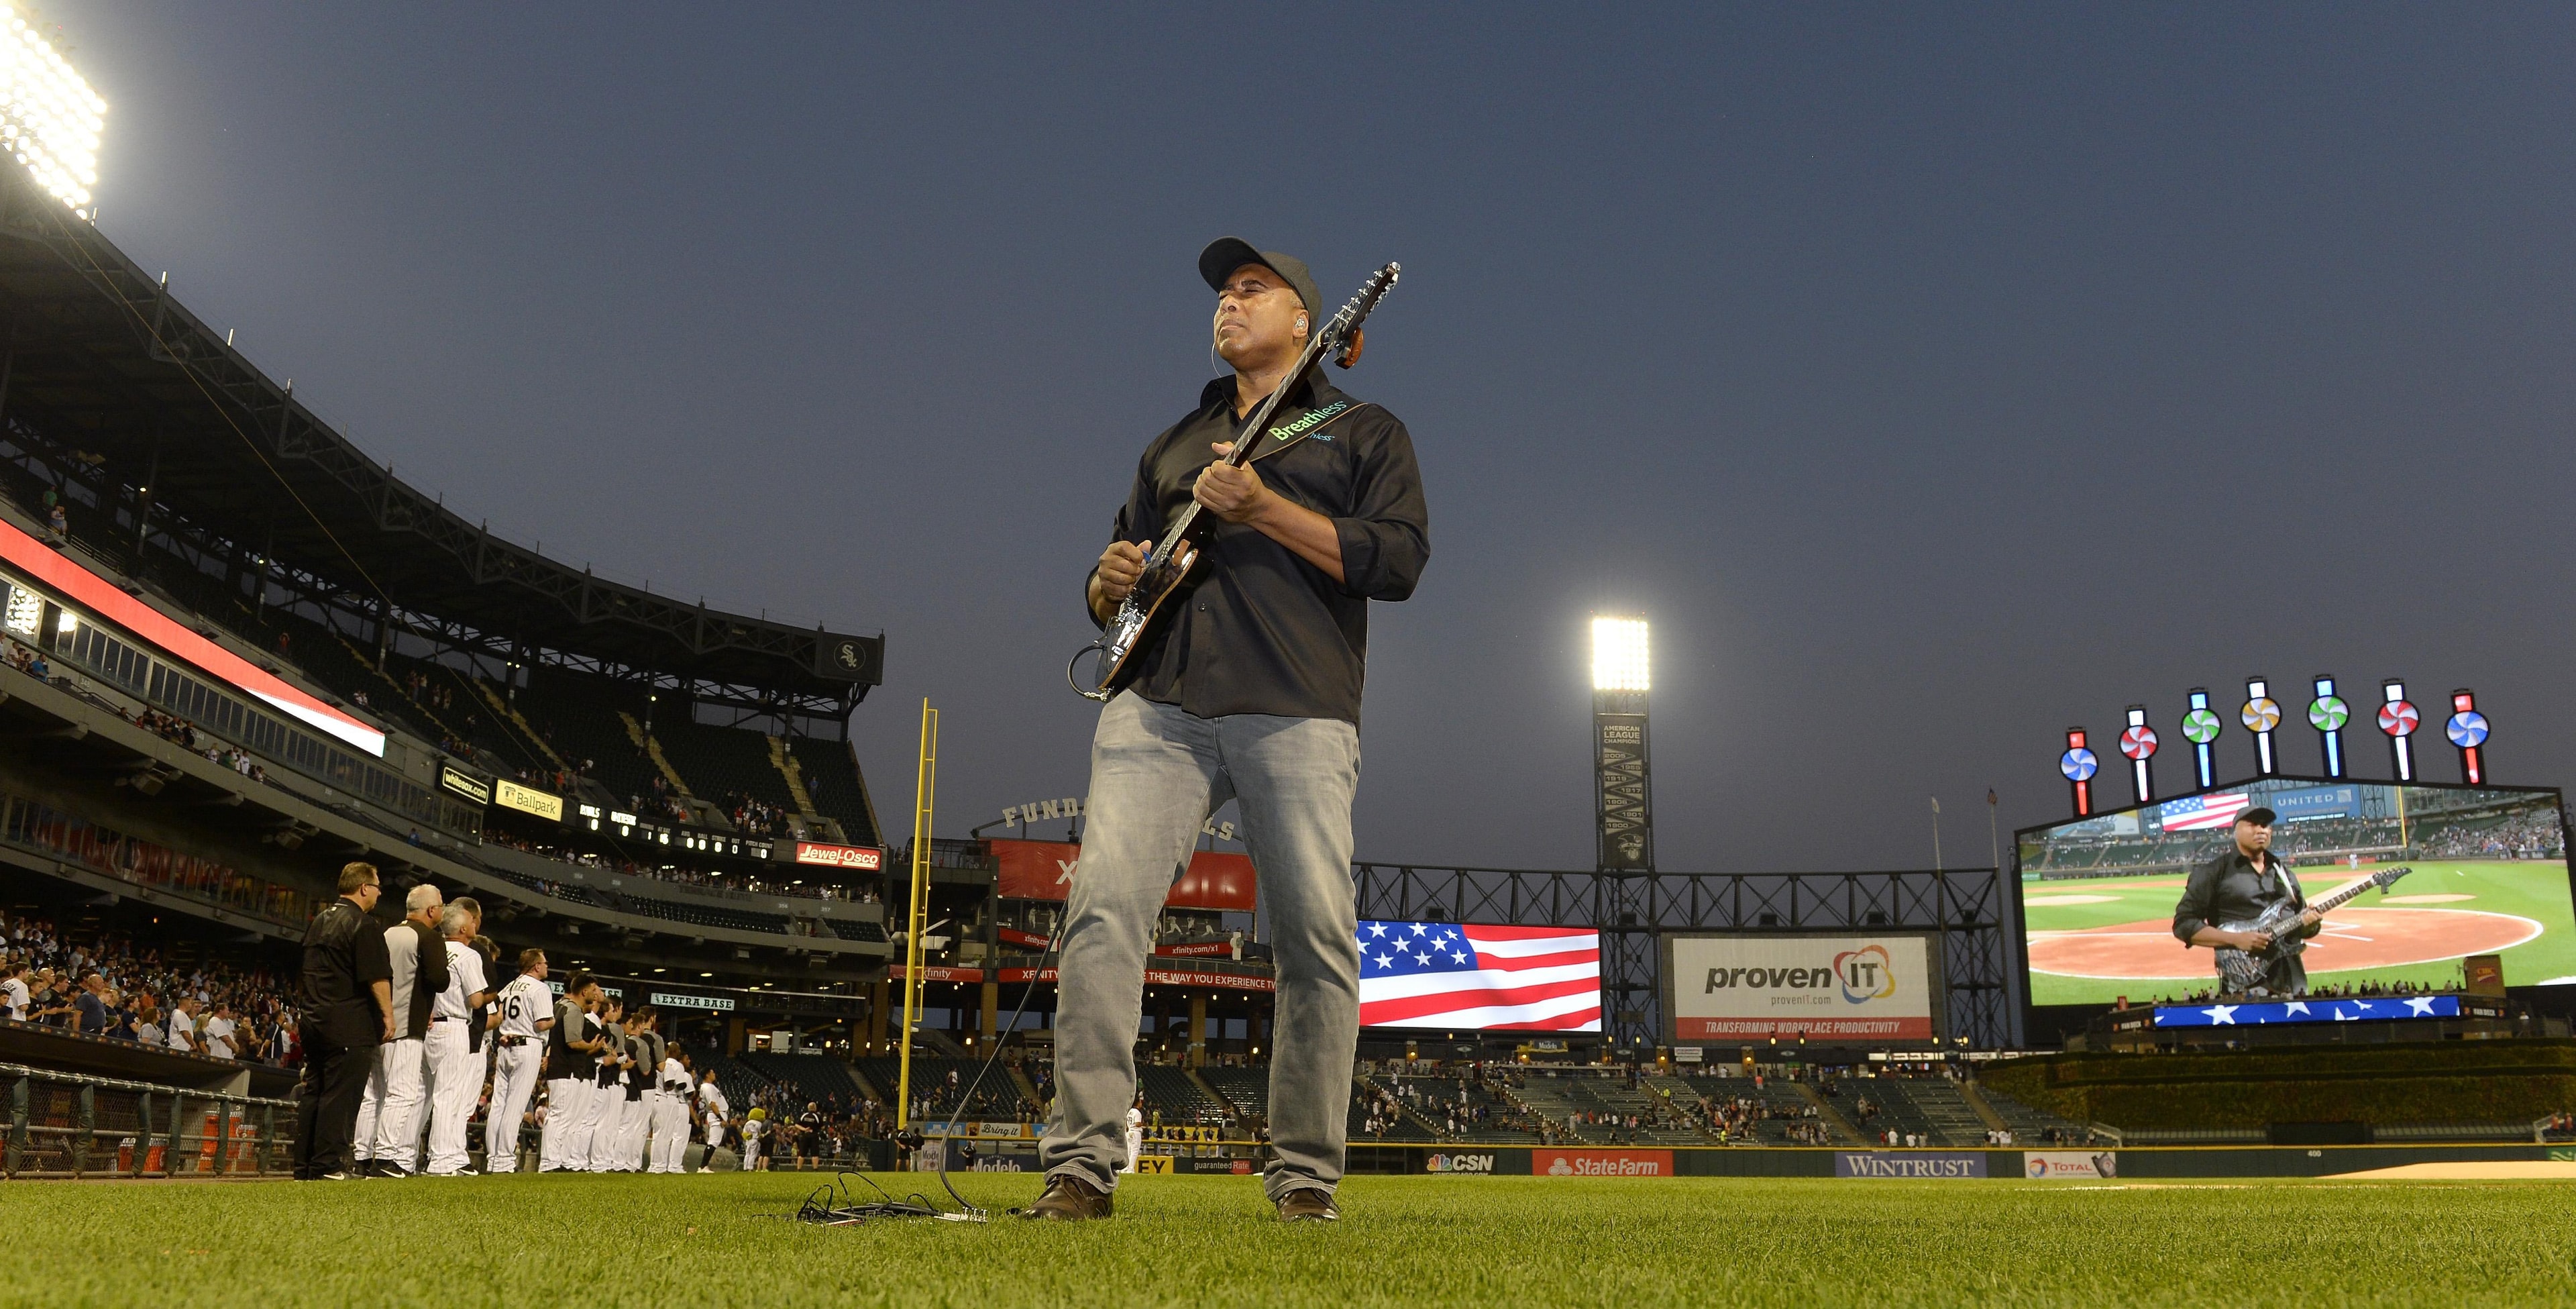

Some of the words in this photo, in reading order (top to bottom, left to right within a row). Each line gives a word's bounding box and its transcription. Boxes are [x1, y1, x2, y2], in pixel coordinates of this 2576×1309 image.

[1269, 402, 1347, 441] Breathless
[445, 772, 487, 800] whitesox.com
[517, 792, 556, 815] Ballpark
[2277, 794, 2334, 806] UNITED
[732, 845, 738, 854] 0
[799, 845, 879, 865] Jewel-Osco
[1172, 945, 1219, 955] xfinity.com/x1
[1148, 972, 1168, 981] THE
[1170, 973, 1191, 983] WAY
[1193, 974, 1213, 984] YOU
[1215, 976, 1265, 988] EXPERIENCE
[1705, 967, 1833, 994] proven
[1850, 963, 1878, 988] IT
[661, 996, 700, 1006] EXTRA
[704, 998, 733, 1008] BASE
[1771, 994, 1831, 1006] provenIT.com
[1706, 1021, 1776, 1033] TRANSFORMING
[1778, 1021, 1833, 1034] WORKPLACE
[1833, 1021, 1900, 1033] PRODUCTIVITY
[981, 1124, 1010, 1137] Bring
[1010, 1127, 1018, 1136] it
[973, 1158, 1021, 1172] Modelo
[1452, 1155, 1494, 1171] CSN
[1846, 1155, 1975, 1176] WINTRUST
[2052, 1162, 2092, 1171] TOTAL
